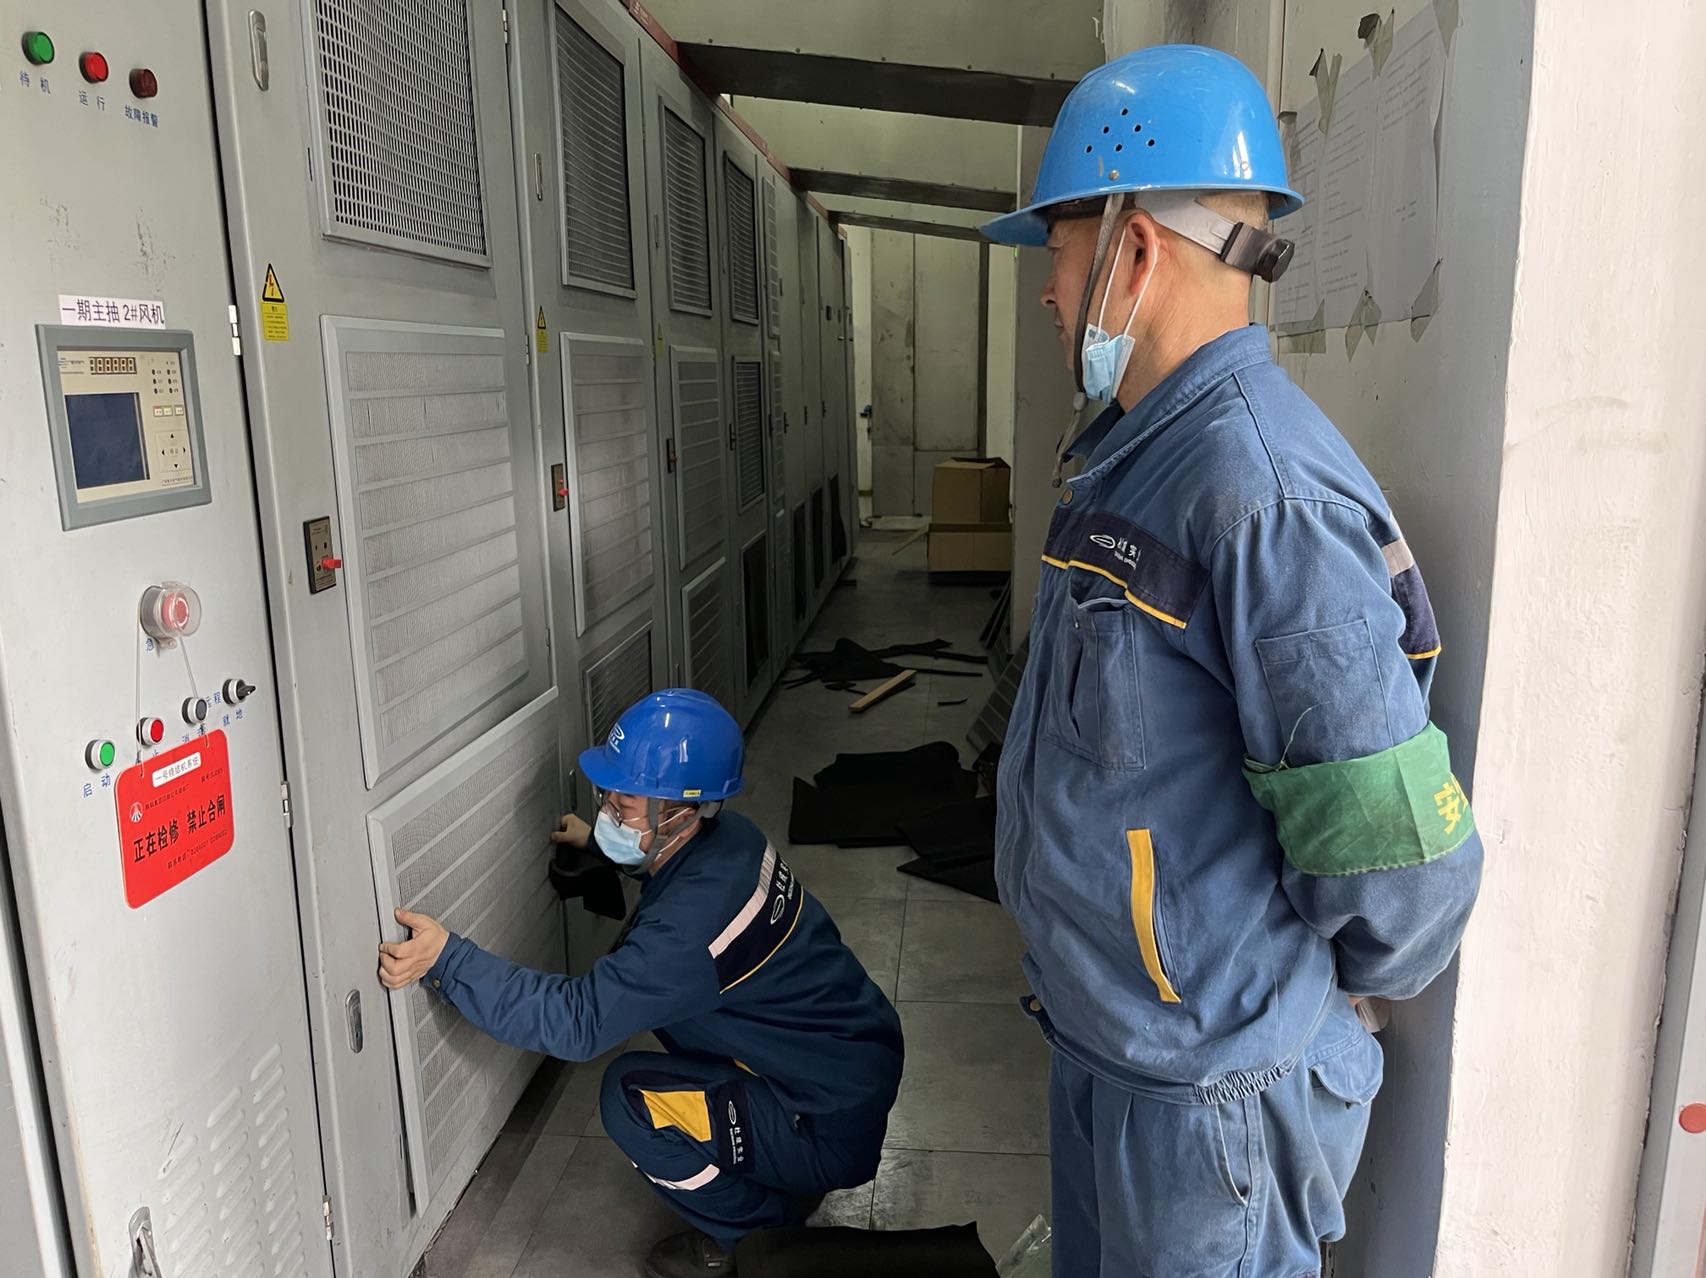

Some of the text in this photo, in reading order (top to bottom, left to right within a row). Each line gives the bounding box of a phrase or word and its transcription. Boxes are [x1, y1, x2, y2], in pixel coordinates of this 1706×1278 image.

[79, 90, 105, 112] 运行
[124, 104, 158, 128] 故障报警
[62, 299, 164, 324] 一期主抽 2#风机
[83, 772, 111, 799] 启动
[133, 818, 180, 863] 正在检修
[186, 794, 226, 834] 禁止合闸
